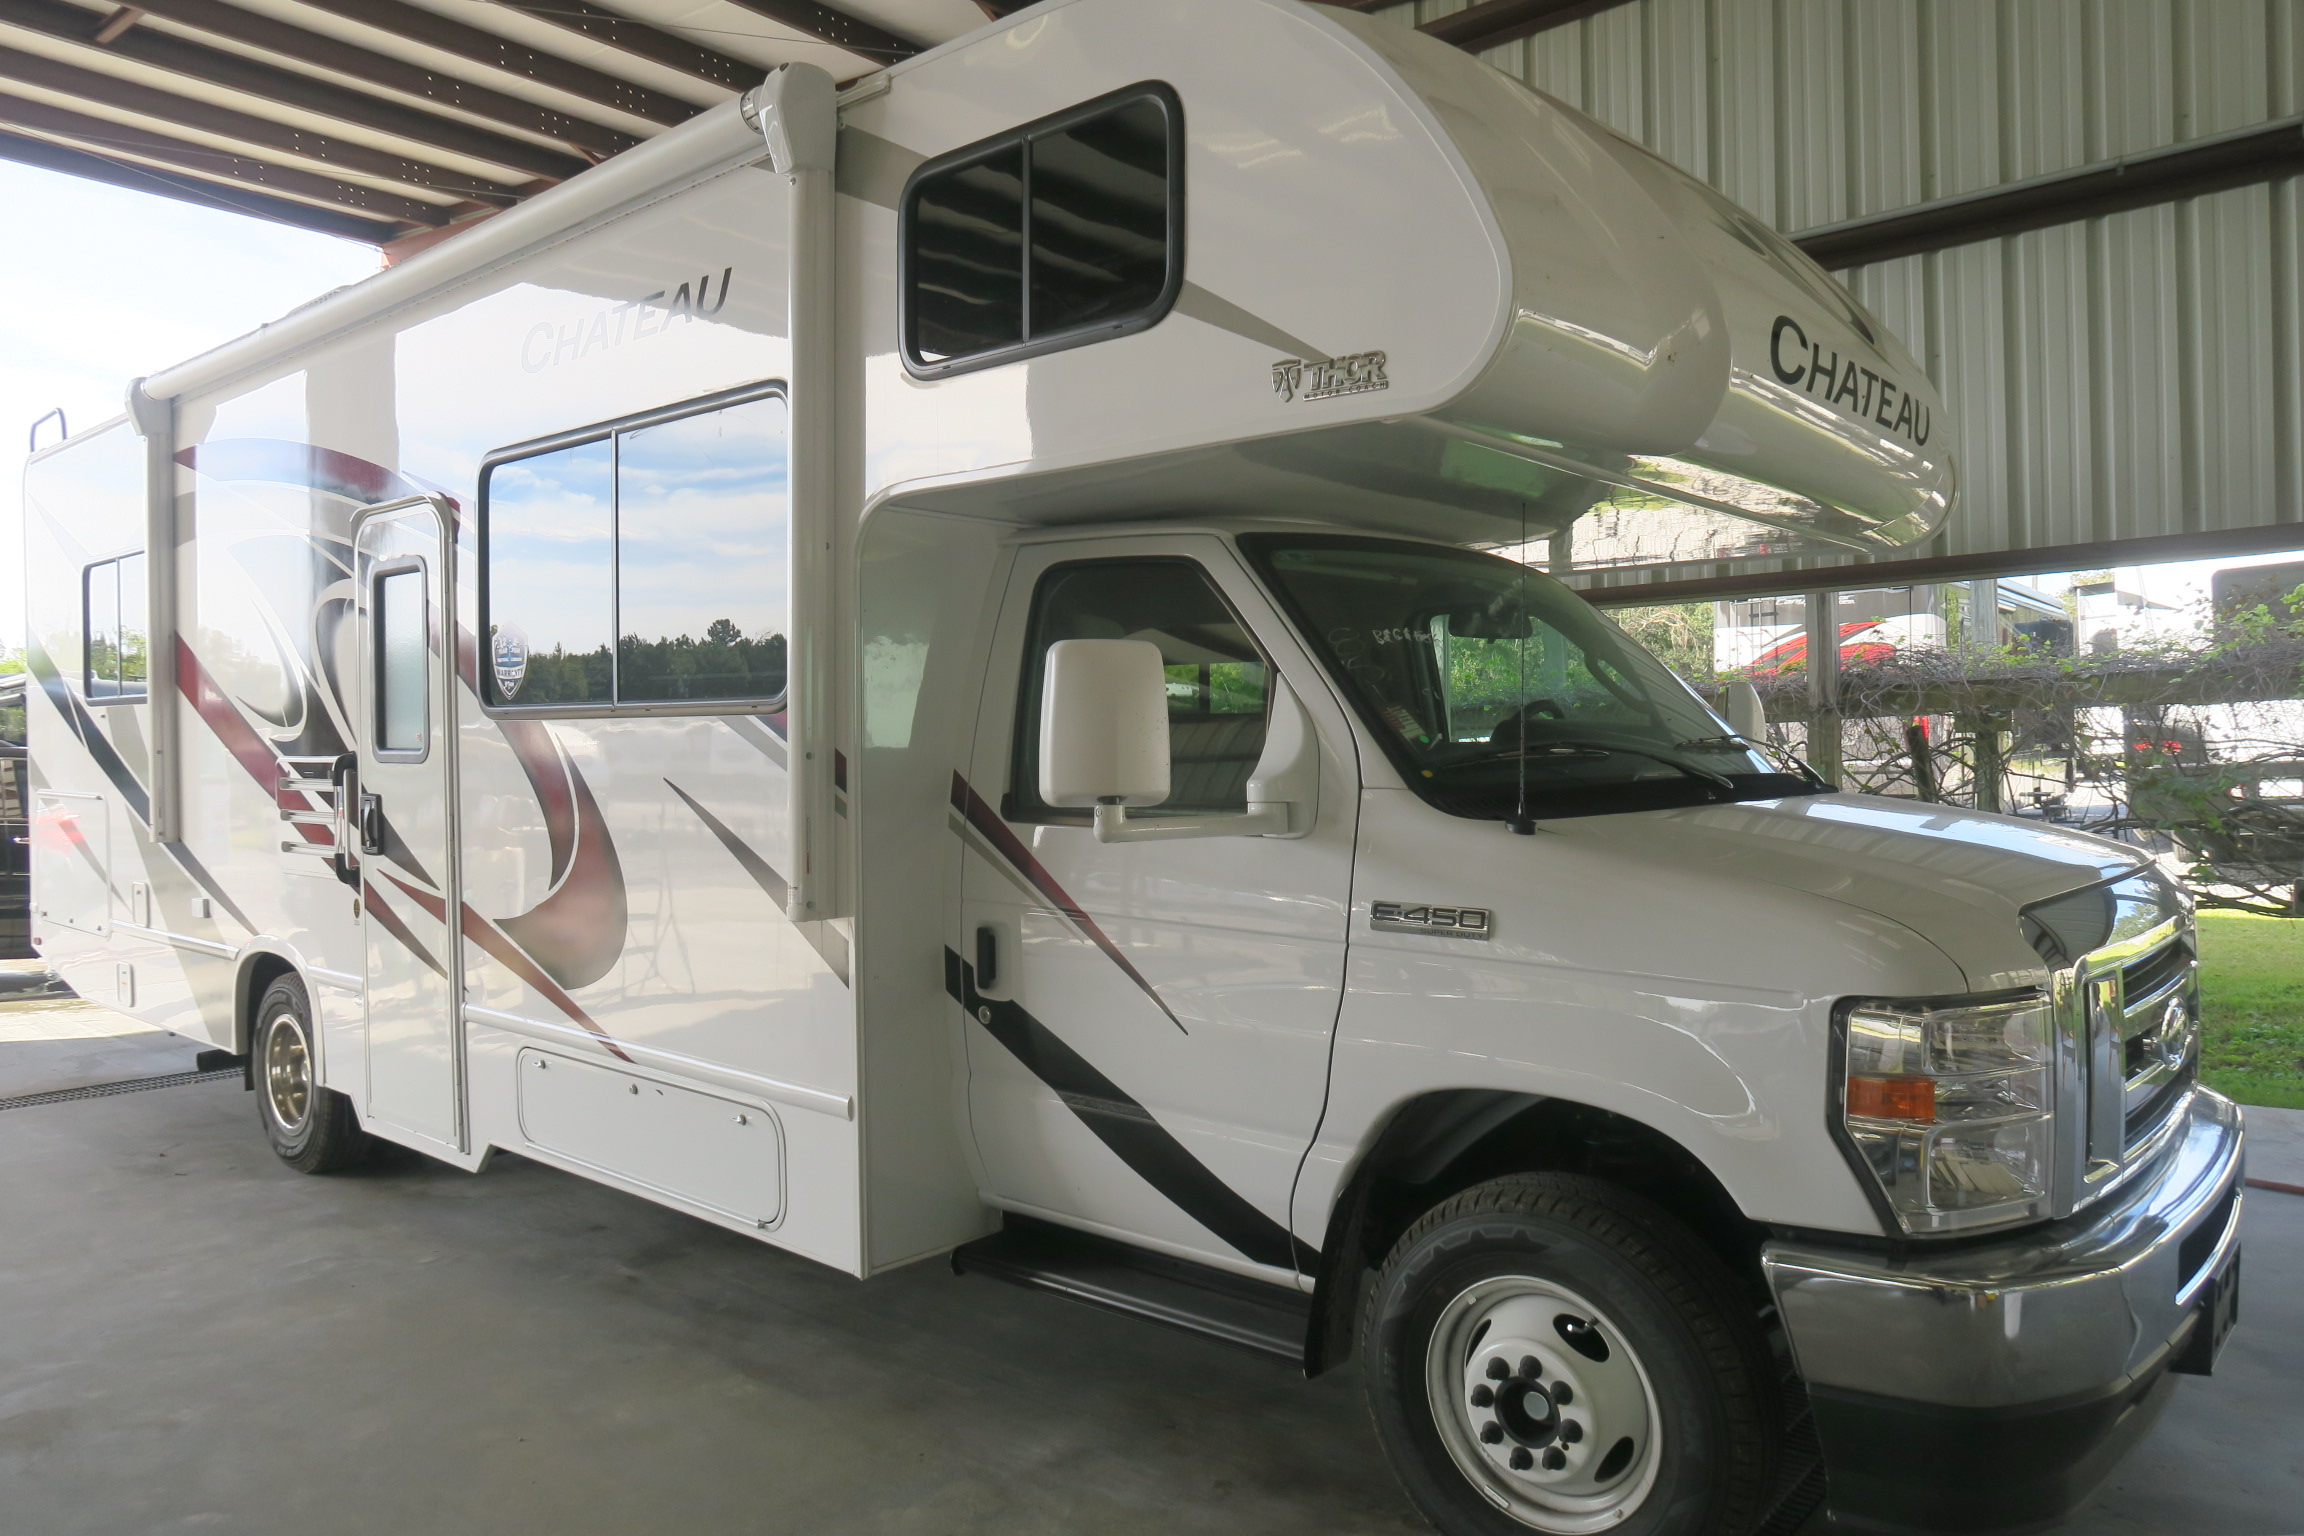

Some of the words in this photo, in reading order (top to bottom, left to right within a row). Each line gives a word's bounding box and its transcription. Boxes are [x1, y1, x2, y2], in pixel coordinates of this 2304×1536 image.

[521, 266, 732, 374] CHATEAU
[1303, 350, 1388, 391] THOR
[1770, 315, 1930, 447] CHATEAU
[1304, 388, 1340, 399] MOTOR
[1348, 381, 1385, 393] COACH
[1371, 902, 1487, 930] E-450
[1420, 927, 1453, 937] SUPER
[1455, 931, 1484, 940] DUTY
